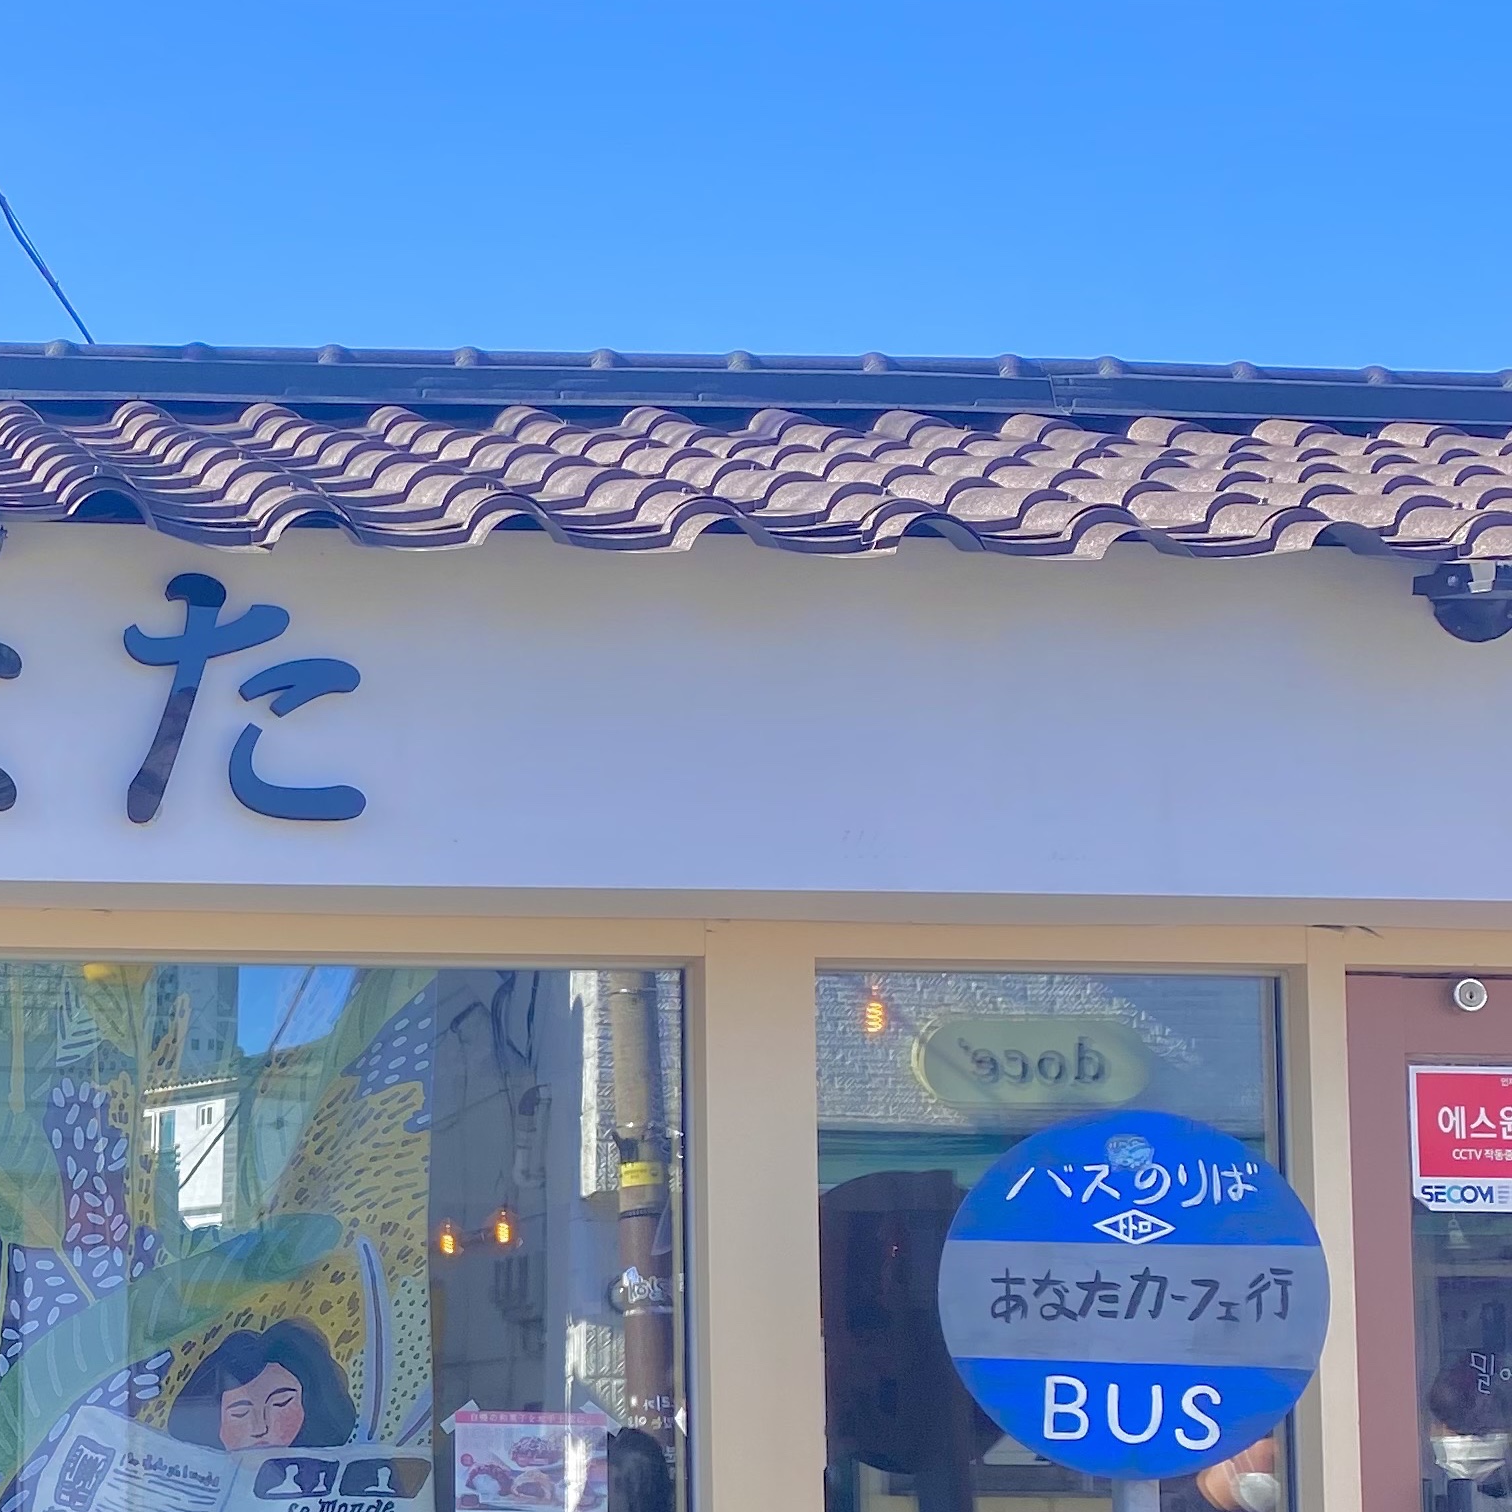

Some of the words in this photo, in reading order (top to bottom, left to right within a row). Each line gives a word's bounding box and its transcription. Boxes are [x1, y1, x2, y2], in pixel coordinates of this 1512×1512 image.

[1452, 1148, 1482, 1161] CCTV
[1004, 1158, 1260, 1208] バスのりば
[1421, 1185, 1495, 1204] SECOM
[990, 1266, 1294, 1323] あなたカーフェ行
[1043, 1375, 1222, 1451] BUS
